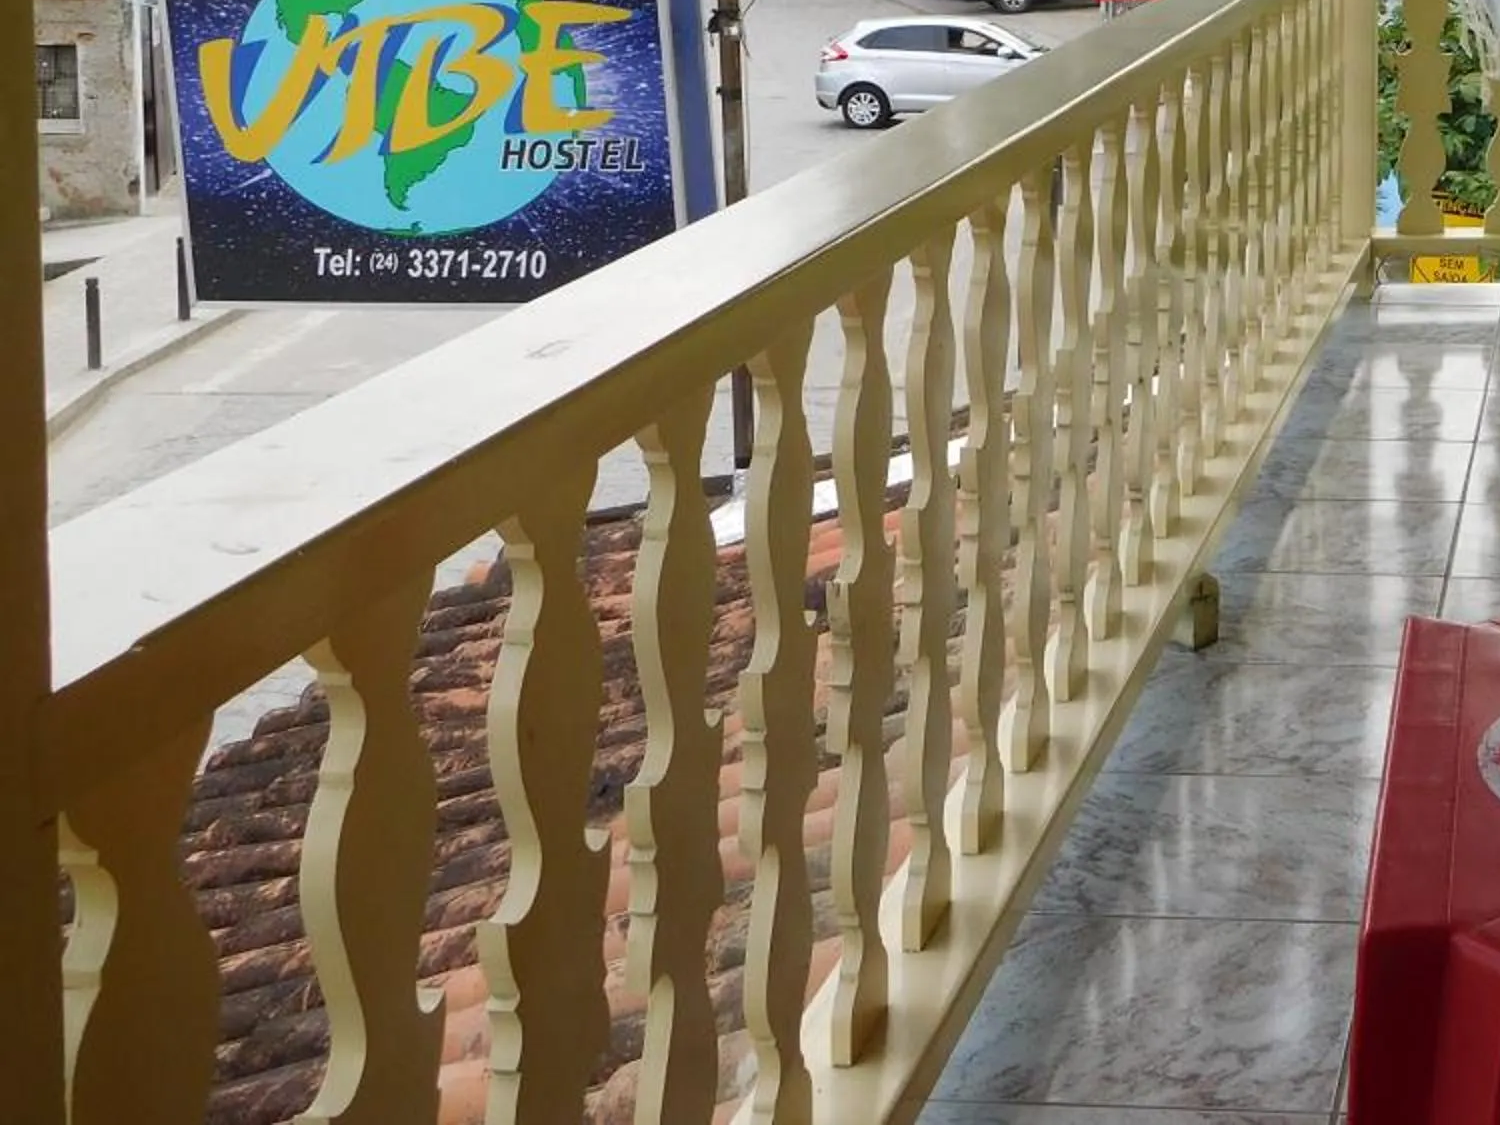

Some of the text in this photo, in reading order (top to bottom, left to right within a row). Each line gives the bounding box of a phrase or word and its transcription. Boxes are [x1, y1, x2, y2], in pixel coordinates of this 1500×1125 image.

[199, 0, 634, 164] VIBE
[500, 137, 646, 172] HOSTEL
[313, 248, 547, 279] Tel: (24) 3371-2710
[1440, 258, 1465, 269] SEM
